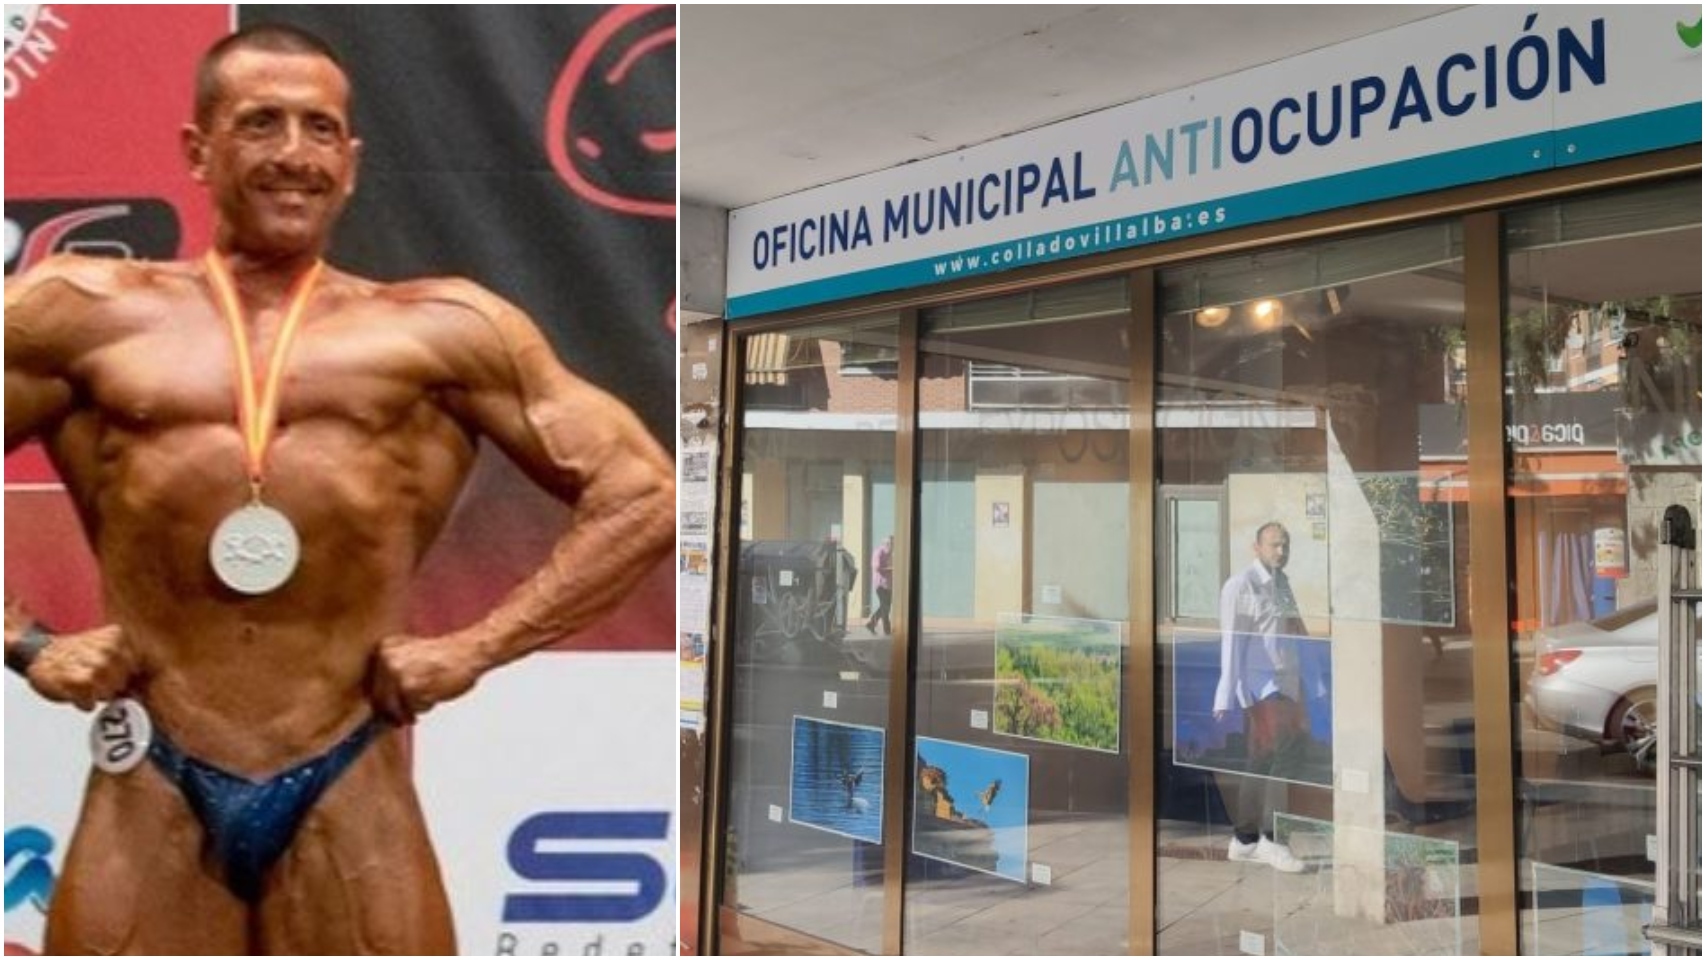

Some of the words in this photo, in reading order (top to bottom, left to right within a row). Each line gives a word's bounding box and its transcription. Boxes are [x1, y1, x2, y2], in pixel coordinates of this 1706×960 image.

[753, 206, 872, 271] OFICINA
[883, 151, 1096, 243] MUNICIPAL
[1109, 13, 1607, 193] ANTIOCUPACIÓN
[934, 207, 1227, 276] www.colladovillalba.es
[501, 811, 675, 921] S
[496, 931, 675, 956] Rede
